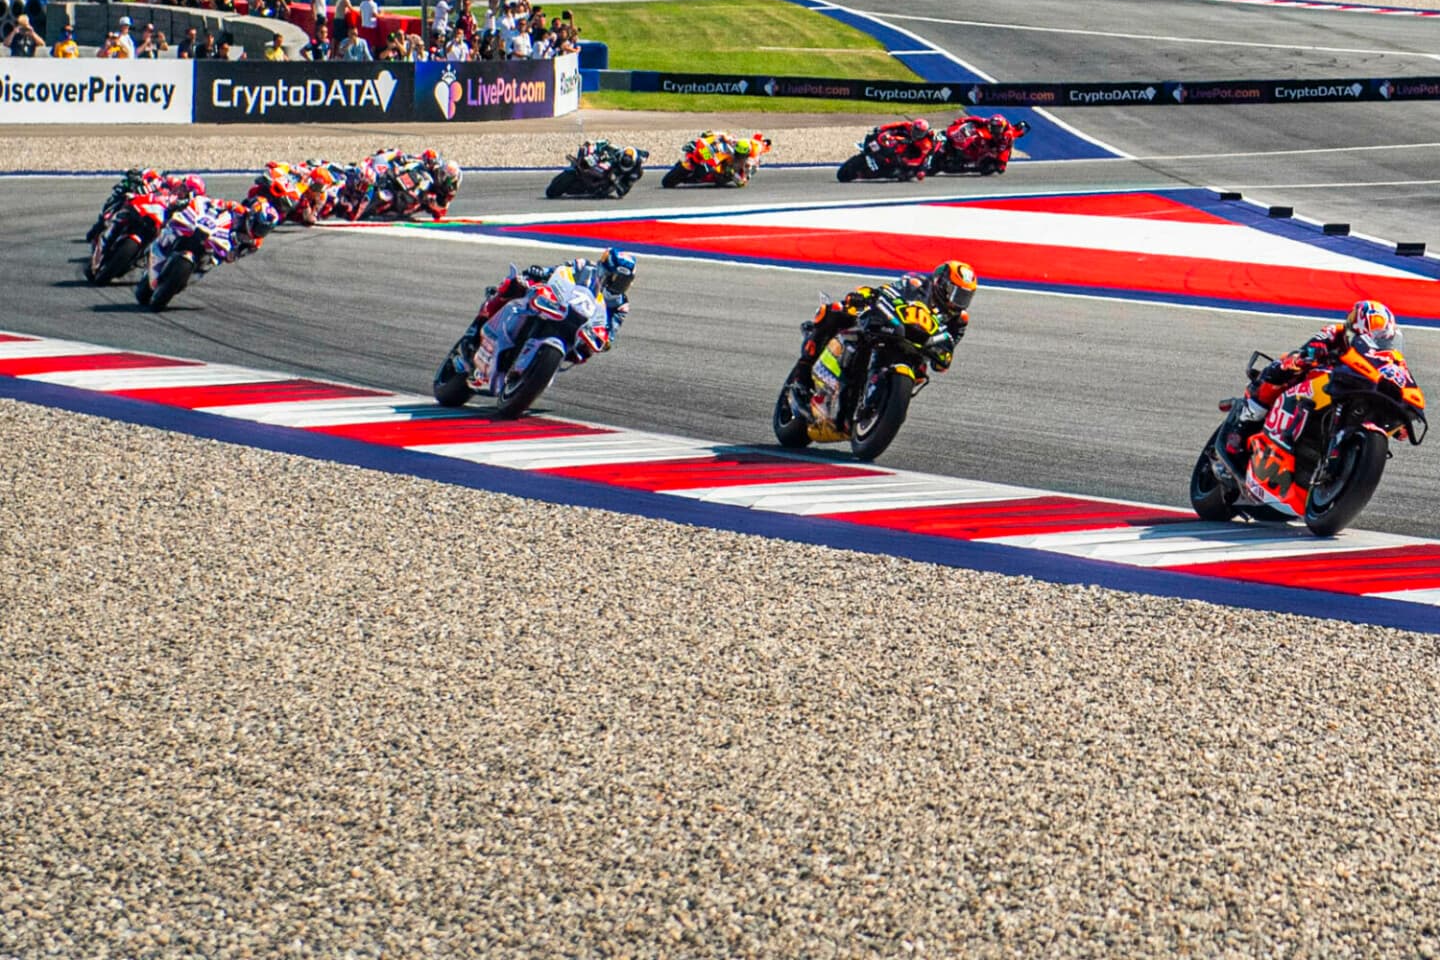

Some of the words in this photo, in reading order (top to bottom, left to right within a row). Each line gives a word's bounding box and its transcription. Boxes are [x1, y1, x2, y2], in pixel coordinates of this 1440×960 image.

[212, 77, 381, 115] CryptoDATA
[466, 77, 546, 107] LivePot.com
[663, 80, 741, 96] CryptoDATA
[865, 86, 942, 101] CryptoDATA
[1069, 89, 1147, 104] CryptoDATA
[1275, 85, 1353, 99] CryptoDATA
[905, 306, 932, 332] 10
